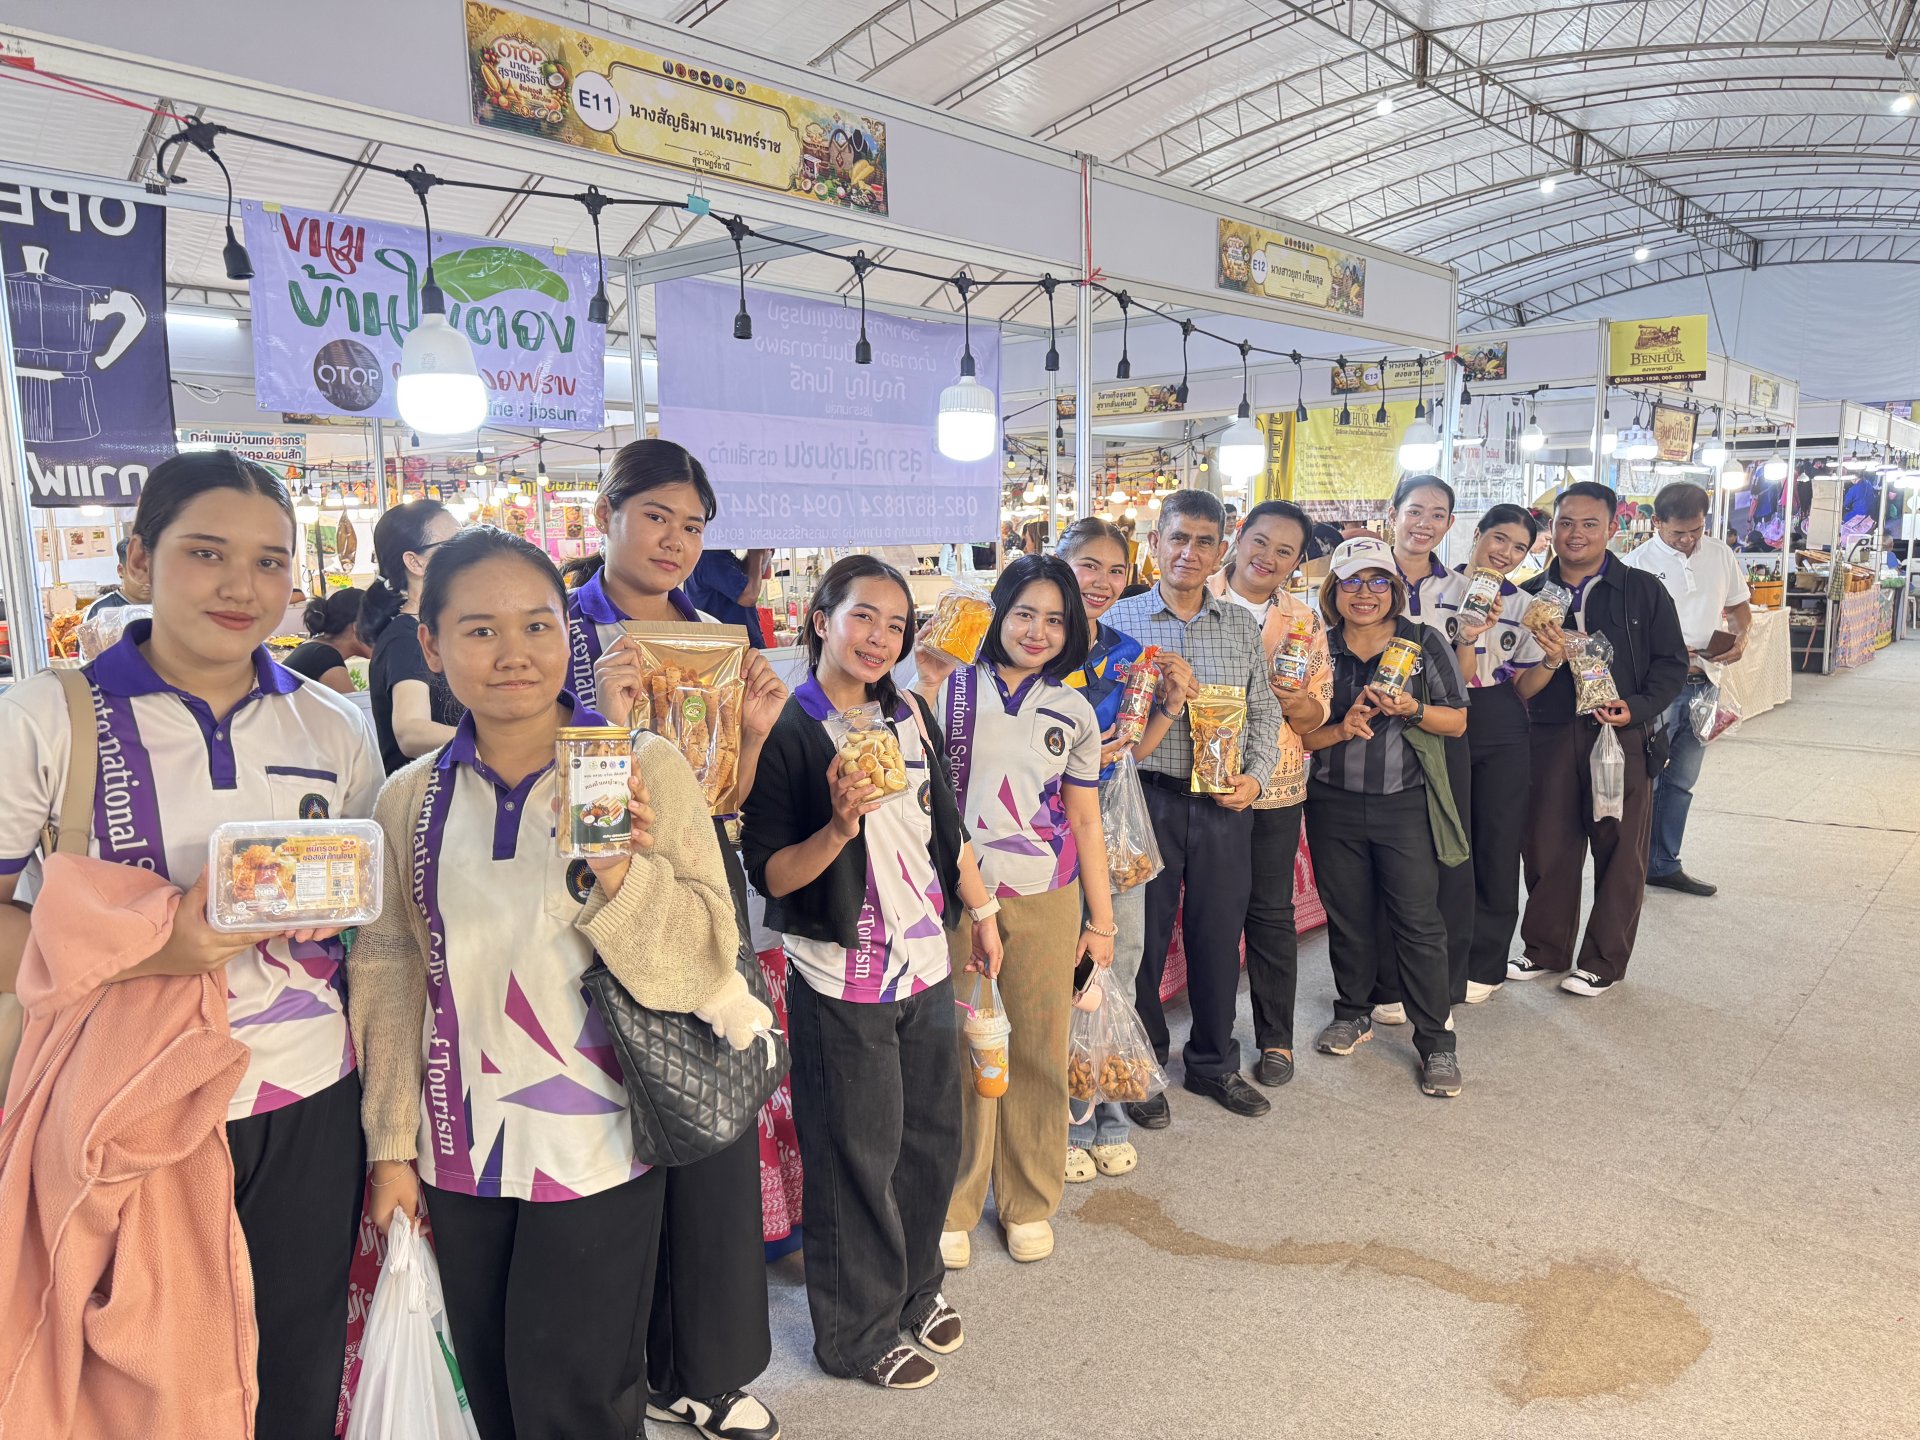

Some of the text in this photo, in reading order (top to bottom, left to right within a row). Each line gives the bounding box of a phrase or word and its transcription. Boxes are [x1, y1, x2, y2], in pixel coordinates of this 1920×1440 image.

[498, 42, 543, 65] OTOP
[578, 89, 613, 114] E11
[629, 104, 781, 154] นางสัญธิมา นเรนทร์ราช
[692, 155, 731, 171] สุราษฎร์ธานี
[280, 213, 366, 275] ขนม
[1252, 259, 1266, 273] E12
[288, 248, 576, 354] บ้านใตอง
[317, 363, 380, 387] OTOP
[1364, 373, 1379, 381] E13
[232, 447, 302, 460] ำเภอ ดอนสัก
[569, 616, 598, 711] Internati
[428, 1052, 457, 1156] Tourism
